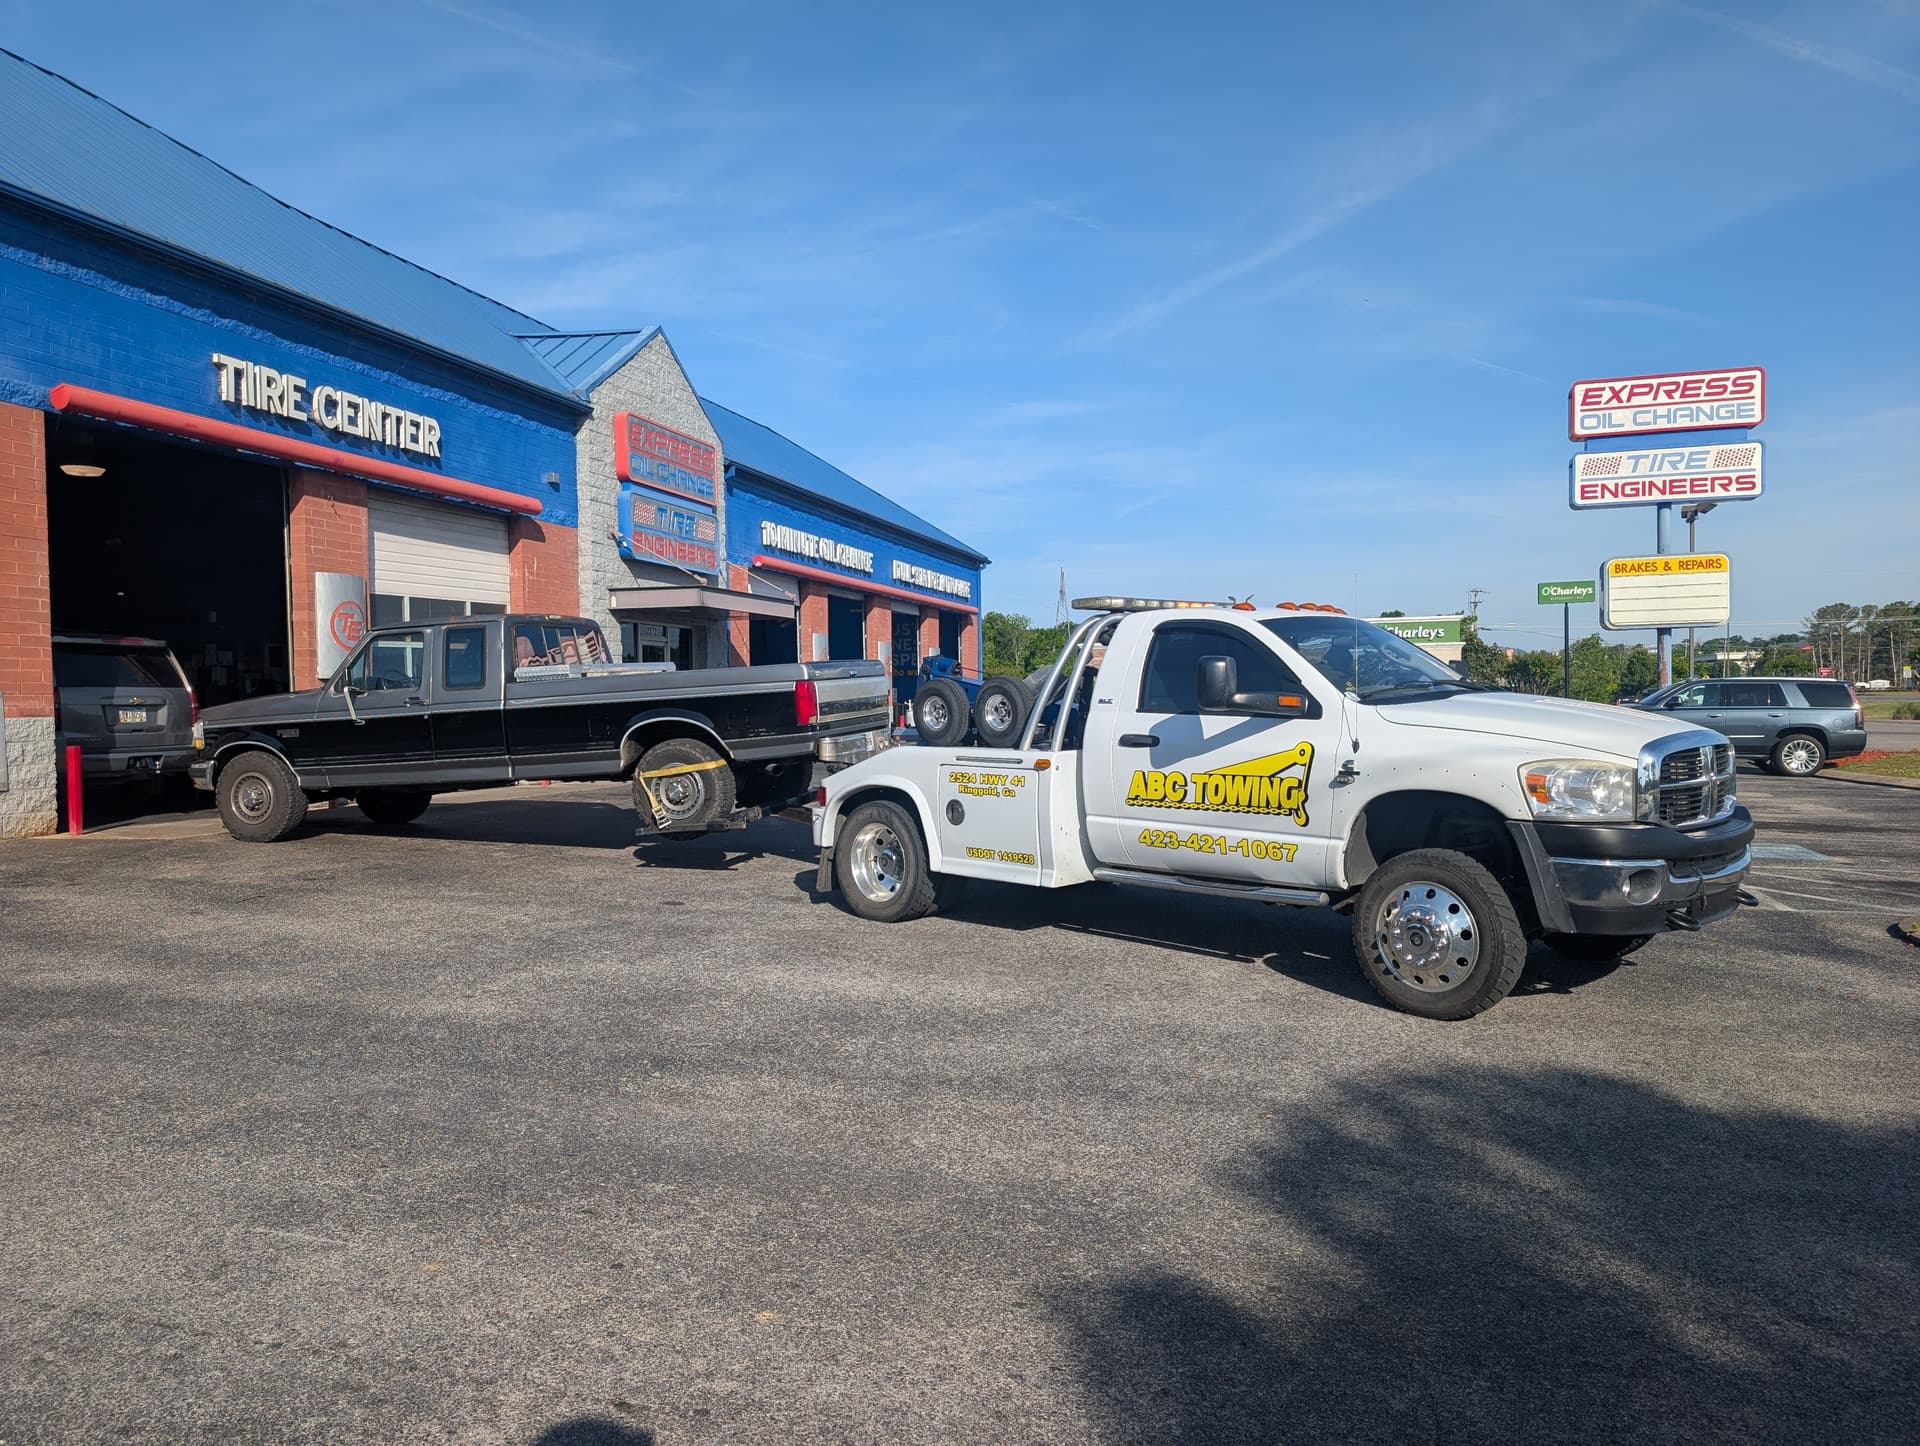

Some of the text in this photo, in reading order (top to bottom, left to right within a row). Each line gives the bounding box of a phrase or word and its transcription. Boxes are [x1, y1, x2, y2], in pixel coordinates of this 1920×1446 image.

[212, 352, 441, 458] TIRE CENTER
[1580, 374, 1757, 407] EXPRESS
[1579, 402, 1756, 431] OIL CHANGE
[630, 422, 714, 471] EXPRESS
[1626, 450, 1711, 474] TIRE
[630, 454, 715, 498] OIL CHANGE
[1580, 474, 1757, 500] ENGINEERS
[656, 506, 697, 538] TIRE
[632, 530, 717, 569] ENGINEERS
[777, 525, 820, 559] MINUTE
[819, 538, 838, 562] OIL
[1614, 558, 1722, 574] BRAKES & REPAIRS
[949, 772, 1026, 787] 2524 HWY 41
[958, 784, 1016, 798] Ringgold, Ga
[1127, 770, 1302, 811] ABC TOWING
[966, 847, 1035, 865] USDOT 1419528
[1138, 829, 1299, 862] 423-421-1067
